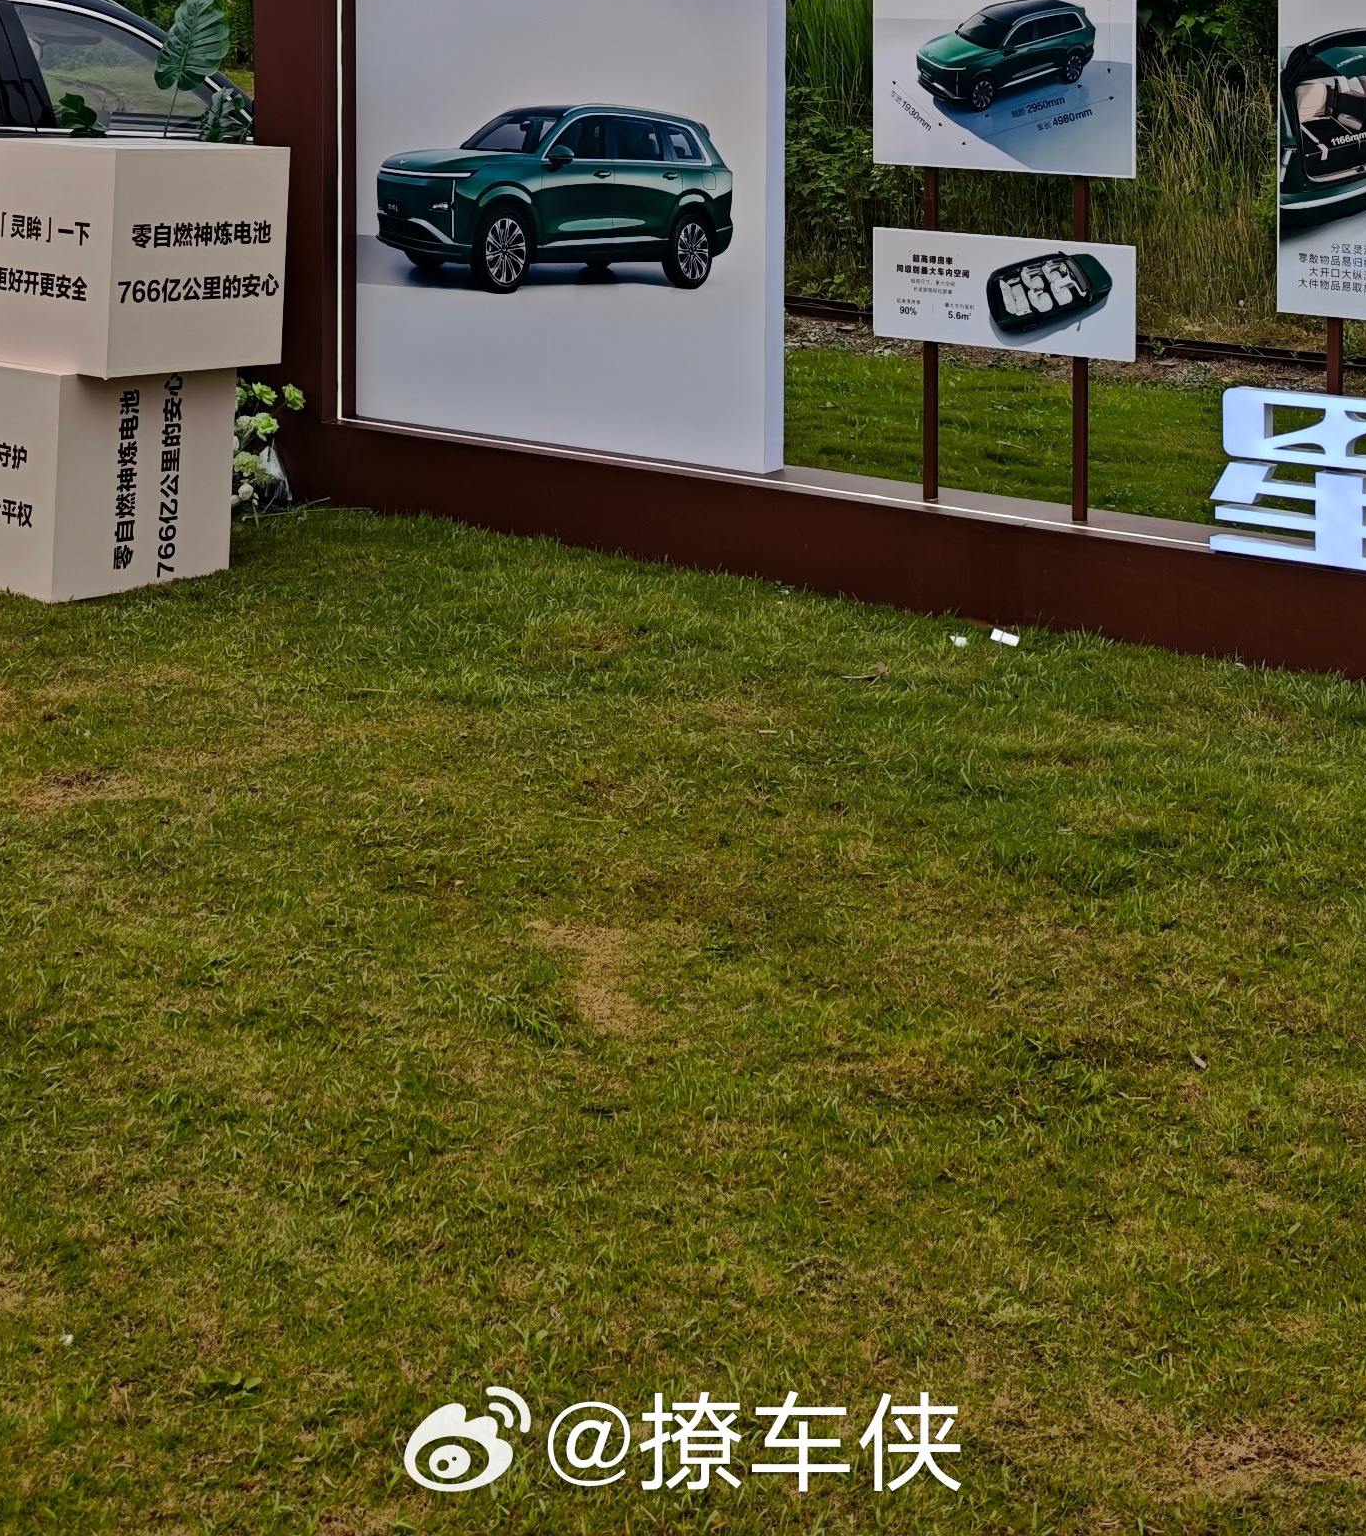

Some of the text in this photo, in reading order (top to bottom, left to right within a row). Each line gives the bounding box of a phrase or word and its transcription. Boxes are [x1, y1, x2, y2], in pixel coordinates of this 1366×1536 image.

[901, 100, 933, 132] 1930mm
[1026, 96, 1066, 114] 2950mm
[1052, 108, 1094, 127] 4980mm
[0, 211, 91, 246] 「灵眸」一下
[131, 220, 273, 249] 零自燃神炼电池
[117, 272, 280, 304] 766亿公里的安心
[899, 306, 918, 316] 90%
[113, 388, 141, 570] 零自燃神炼电池
[156, 372, 184, 579] 766亿公里的安心
